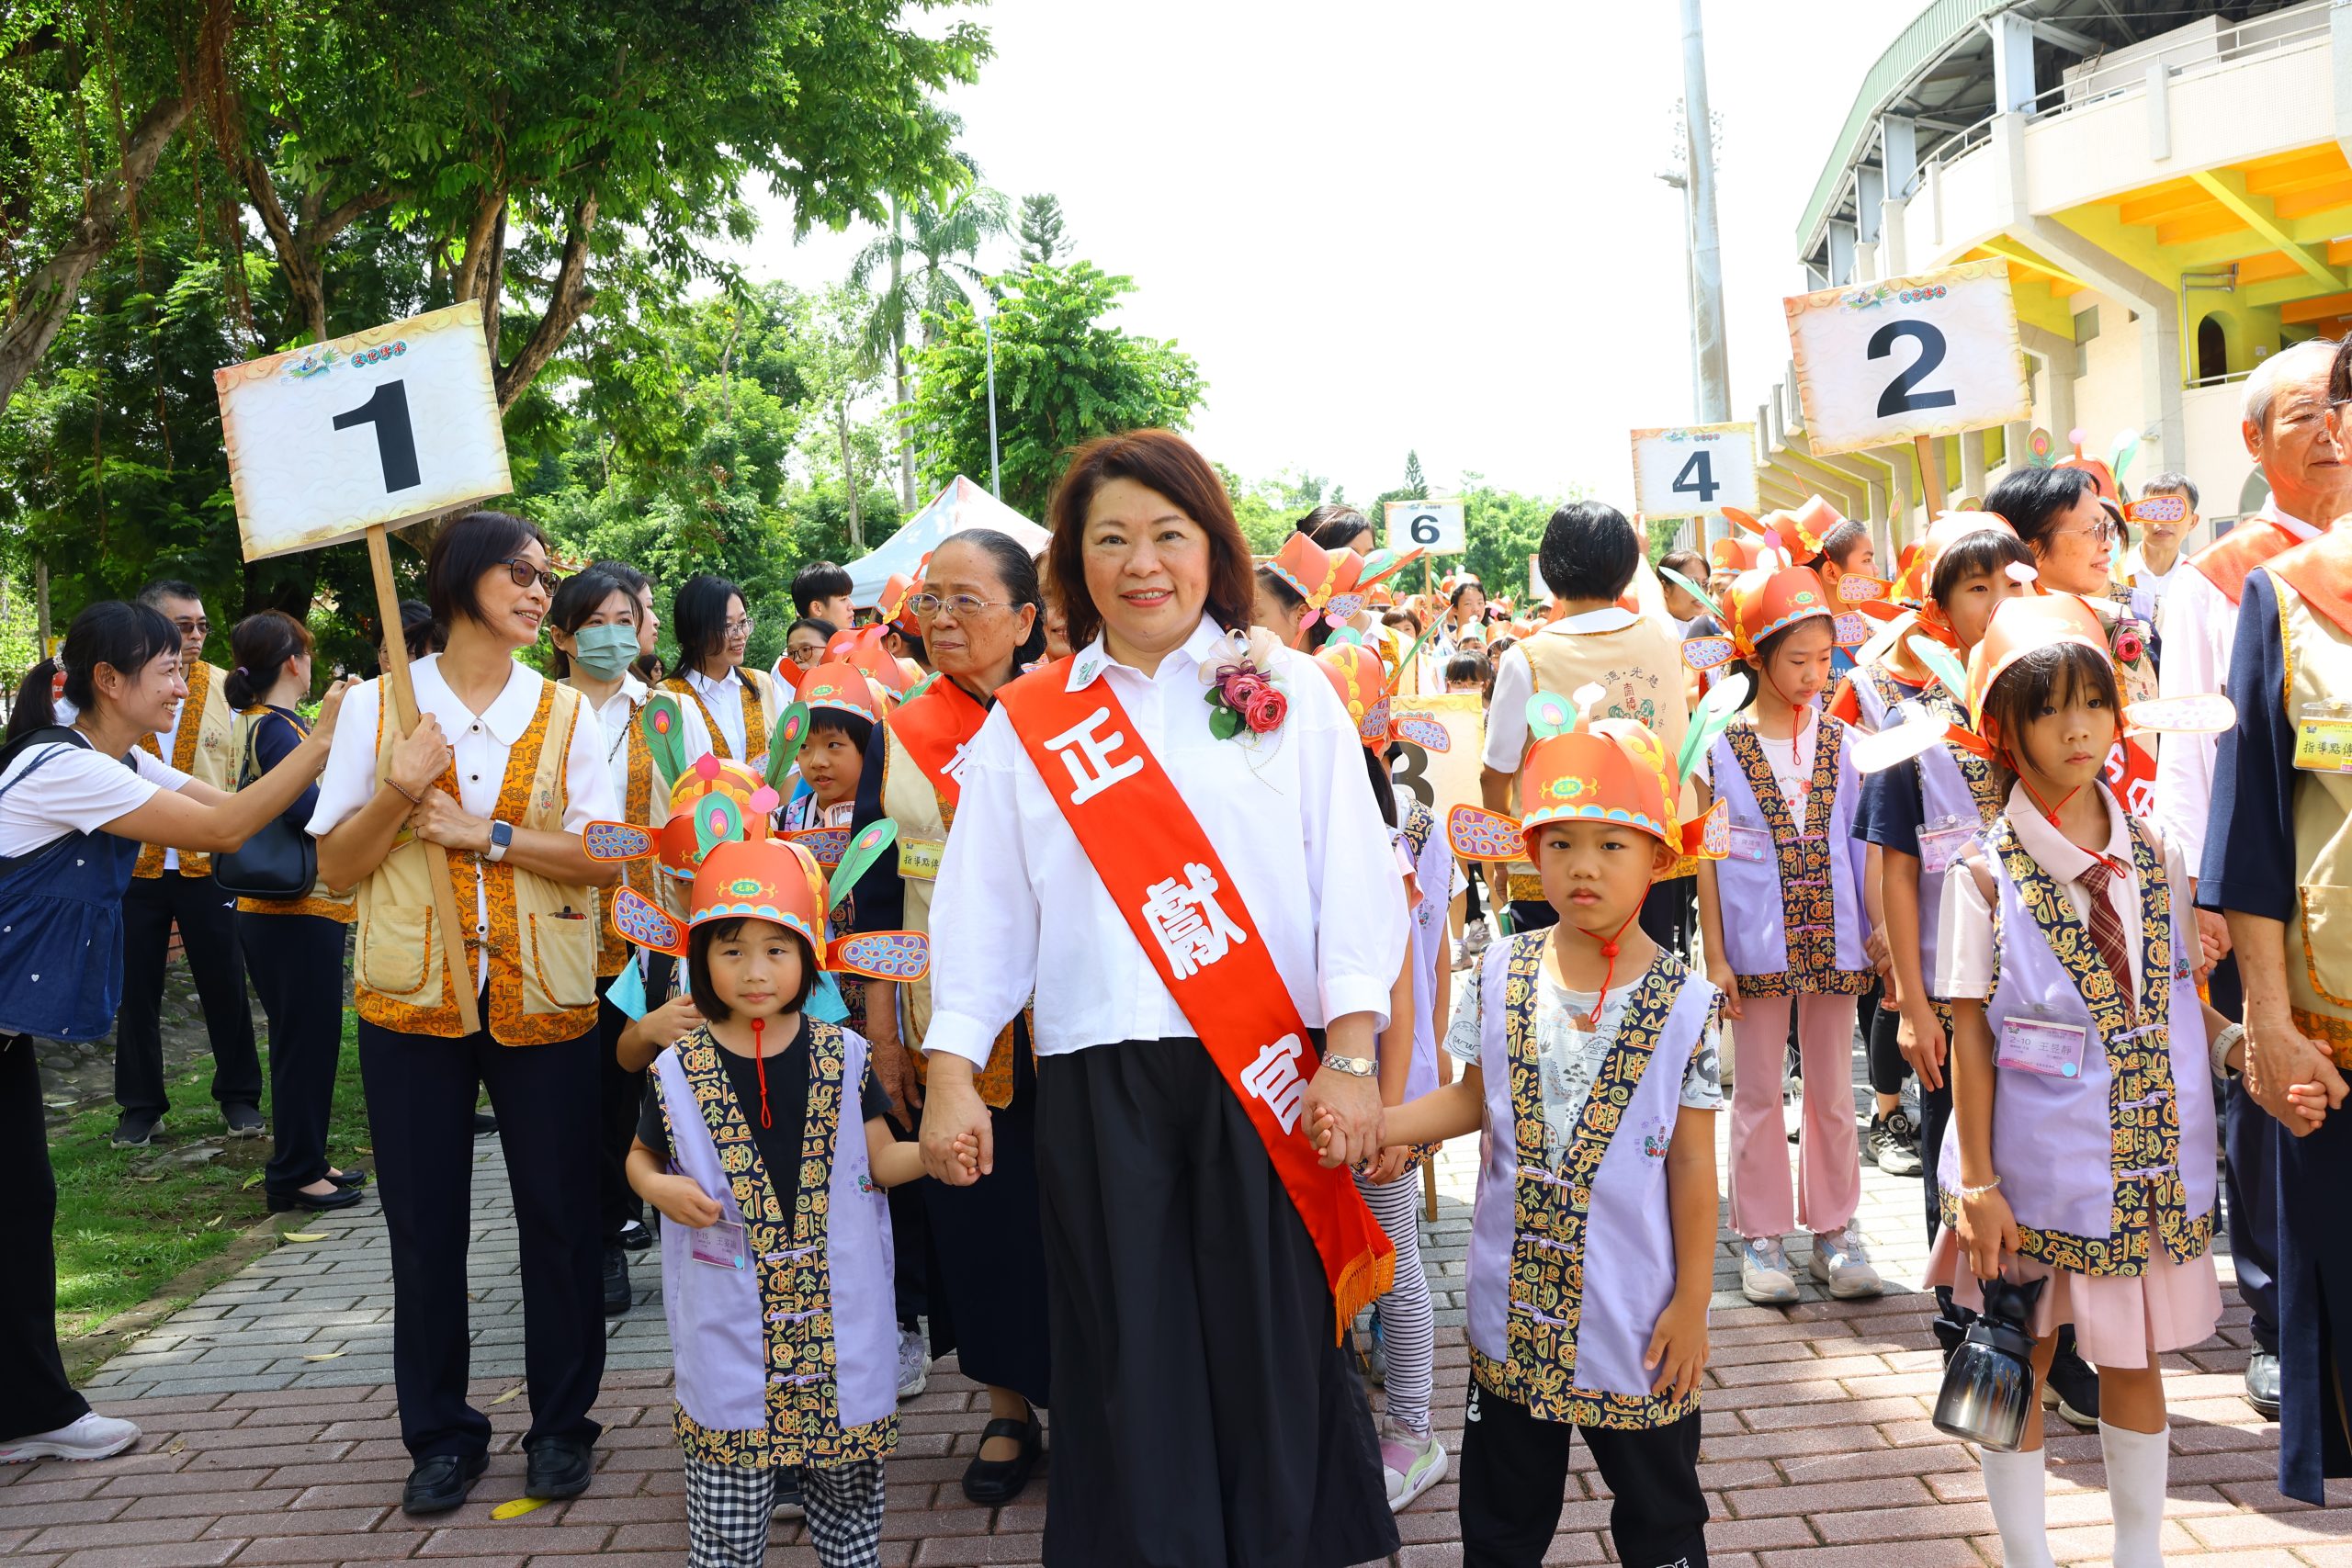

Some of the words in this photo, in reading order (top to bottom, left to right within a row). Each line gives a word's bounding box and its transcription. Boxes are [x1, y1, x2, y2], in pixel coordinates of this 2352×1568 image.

[1840, 320, 1956, 418] 2
[333, 378, 421, 493] 1
[1672, 450, 1720, 502] 4
[1410, 514, 1441, 544] 6
[1044, 706, 1309, 1136] 正獻官
